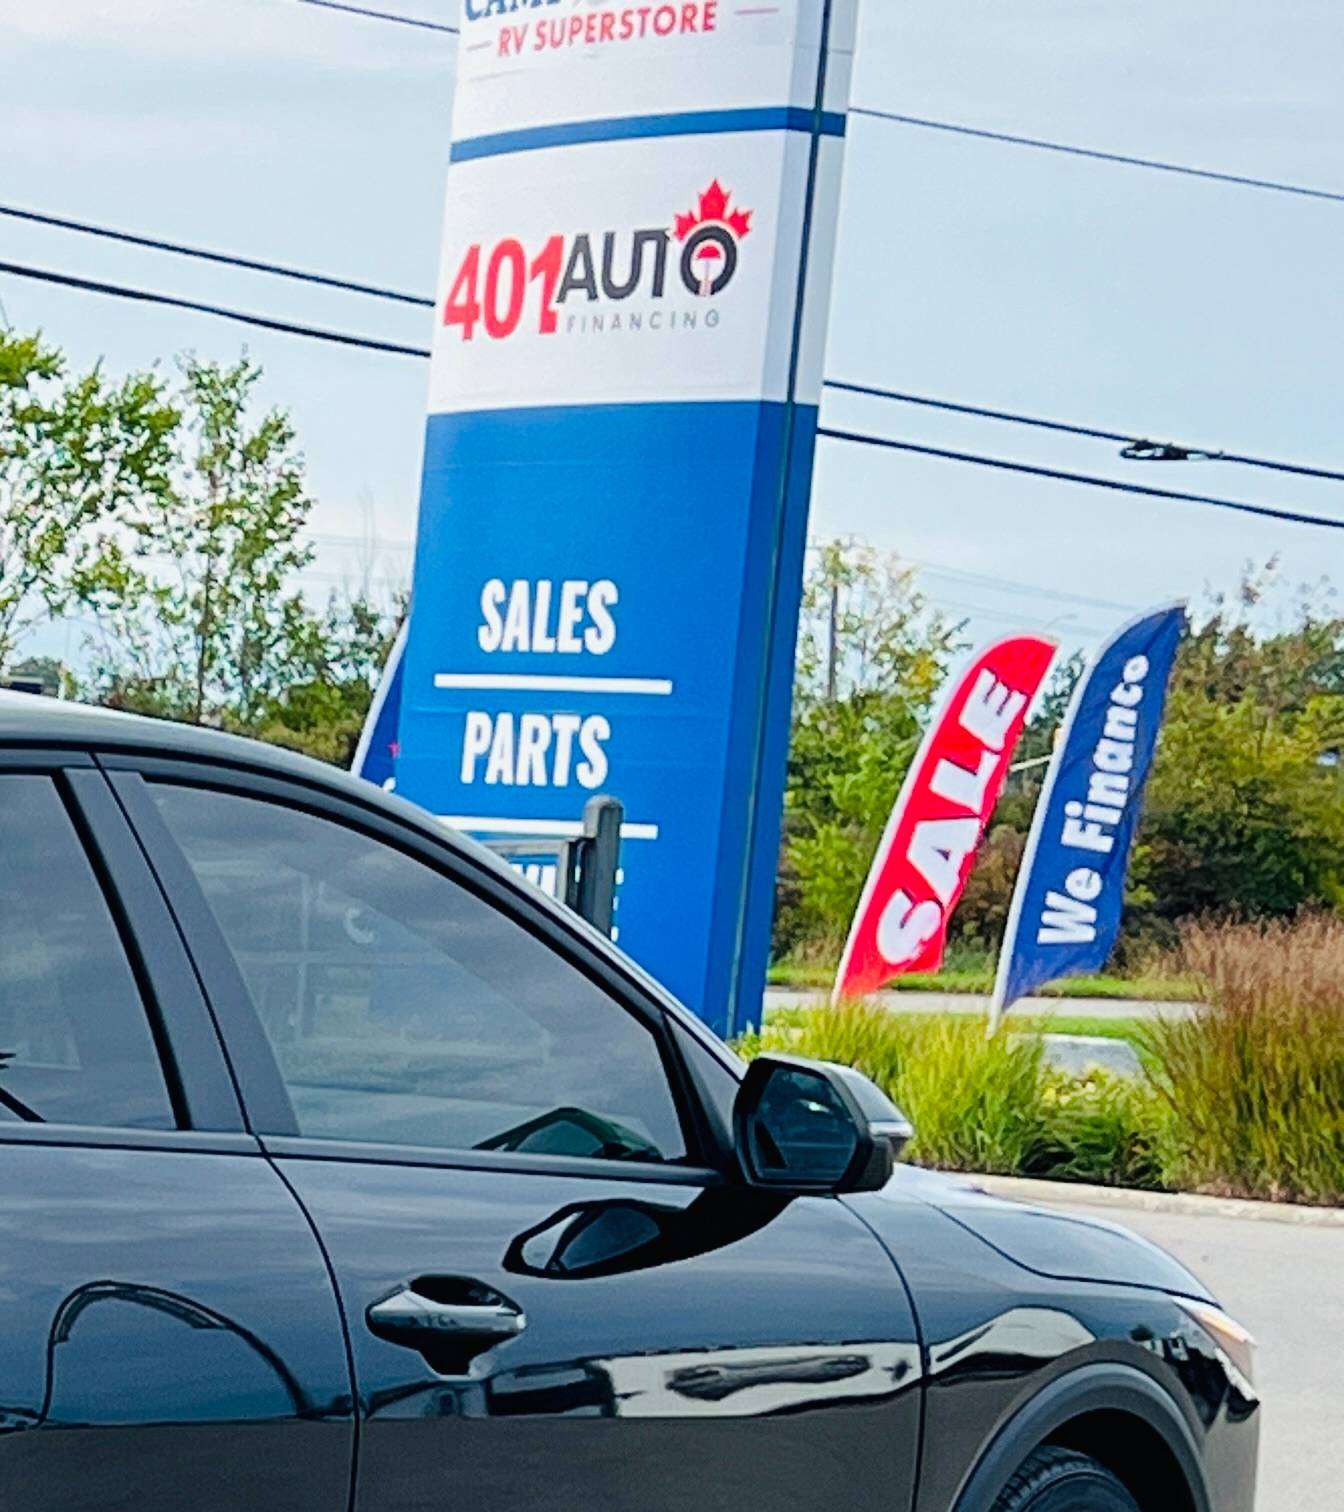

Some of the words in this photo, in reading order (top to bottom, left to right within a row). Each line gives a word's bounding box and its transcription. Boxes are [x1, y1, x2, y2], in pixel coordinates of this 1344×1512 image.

[498, 26, 529, 57] RV
[533, 1, 720, 51] SUPERSTORE
[565, 308, 721, 334] FINANCING
[477, 578, 618, 656] SALES
[461, 711, 611, 790] PARTS
[1062, 653, 1150, 854] Finance
[876, 668, 1028, 965] SALE
[1037, 870, 1103, 946] We
